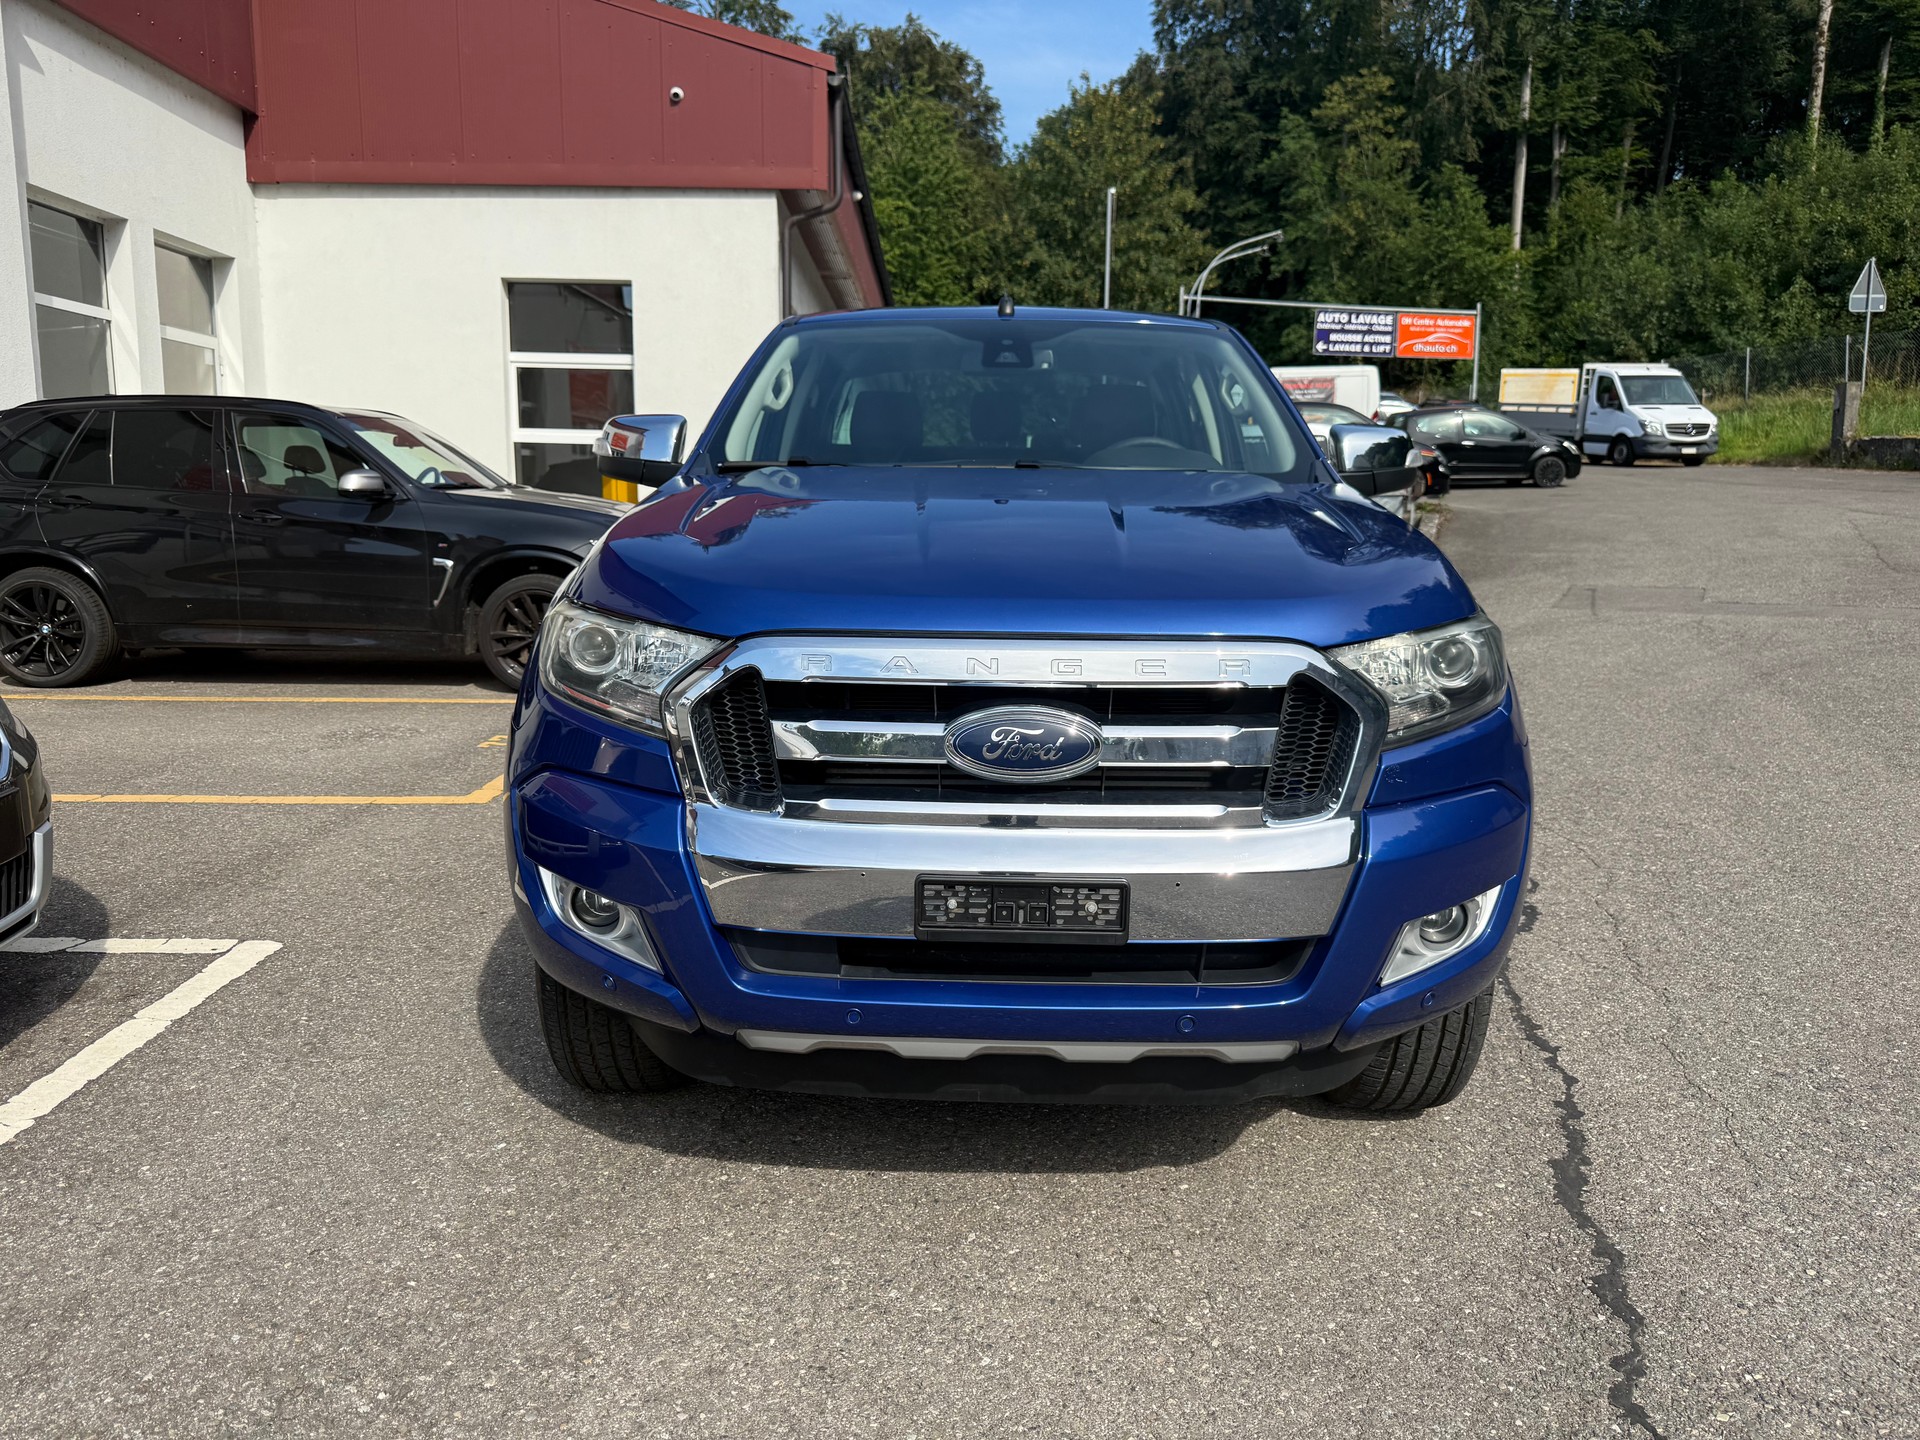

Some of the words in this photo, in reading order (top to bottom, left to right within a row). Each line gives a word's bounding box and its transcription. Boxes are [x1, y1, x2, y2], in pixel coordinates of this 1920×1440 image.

[1317, 312, 1349, 323] AUTO
[1351, 313, 1393, 325] LAVAGE
[1329, 332, 1363, 342] MOUSSE
[1363, 333, 1392, 343] ACTIVE
[1328, 342, 1362, 352] LAVAGE
[1372, 344, 1392, 353] LIFT
[1412, 343, 1458, 353] dhauto.ch
[801, 653, 1251, 677] RANGER
[982, 726, 1065, 761] Ford
